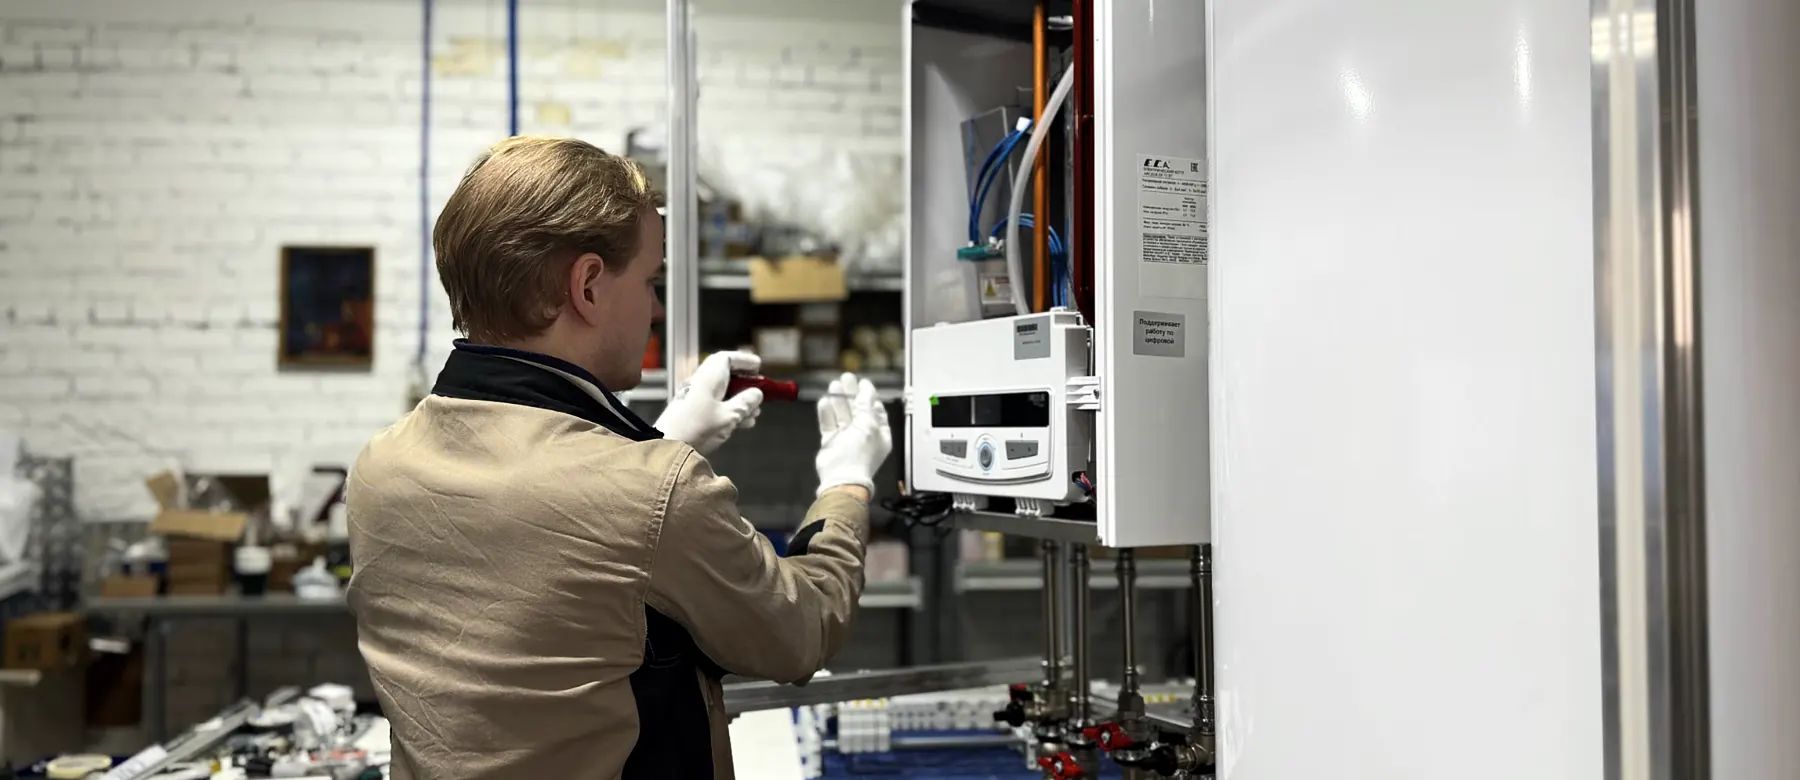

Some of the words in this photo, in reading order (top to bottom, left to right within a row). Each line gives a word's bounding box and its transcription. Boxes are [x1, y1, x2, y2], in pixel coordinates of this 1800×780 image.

[1139, 318, 1180, 328] Поддерживает
[1145, 328, 1165, 337] работу
[1145, 337, 1174, 345] цифровой
